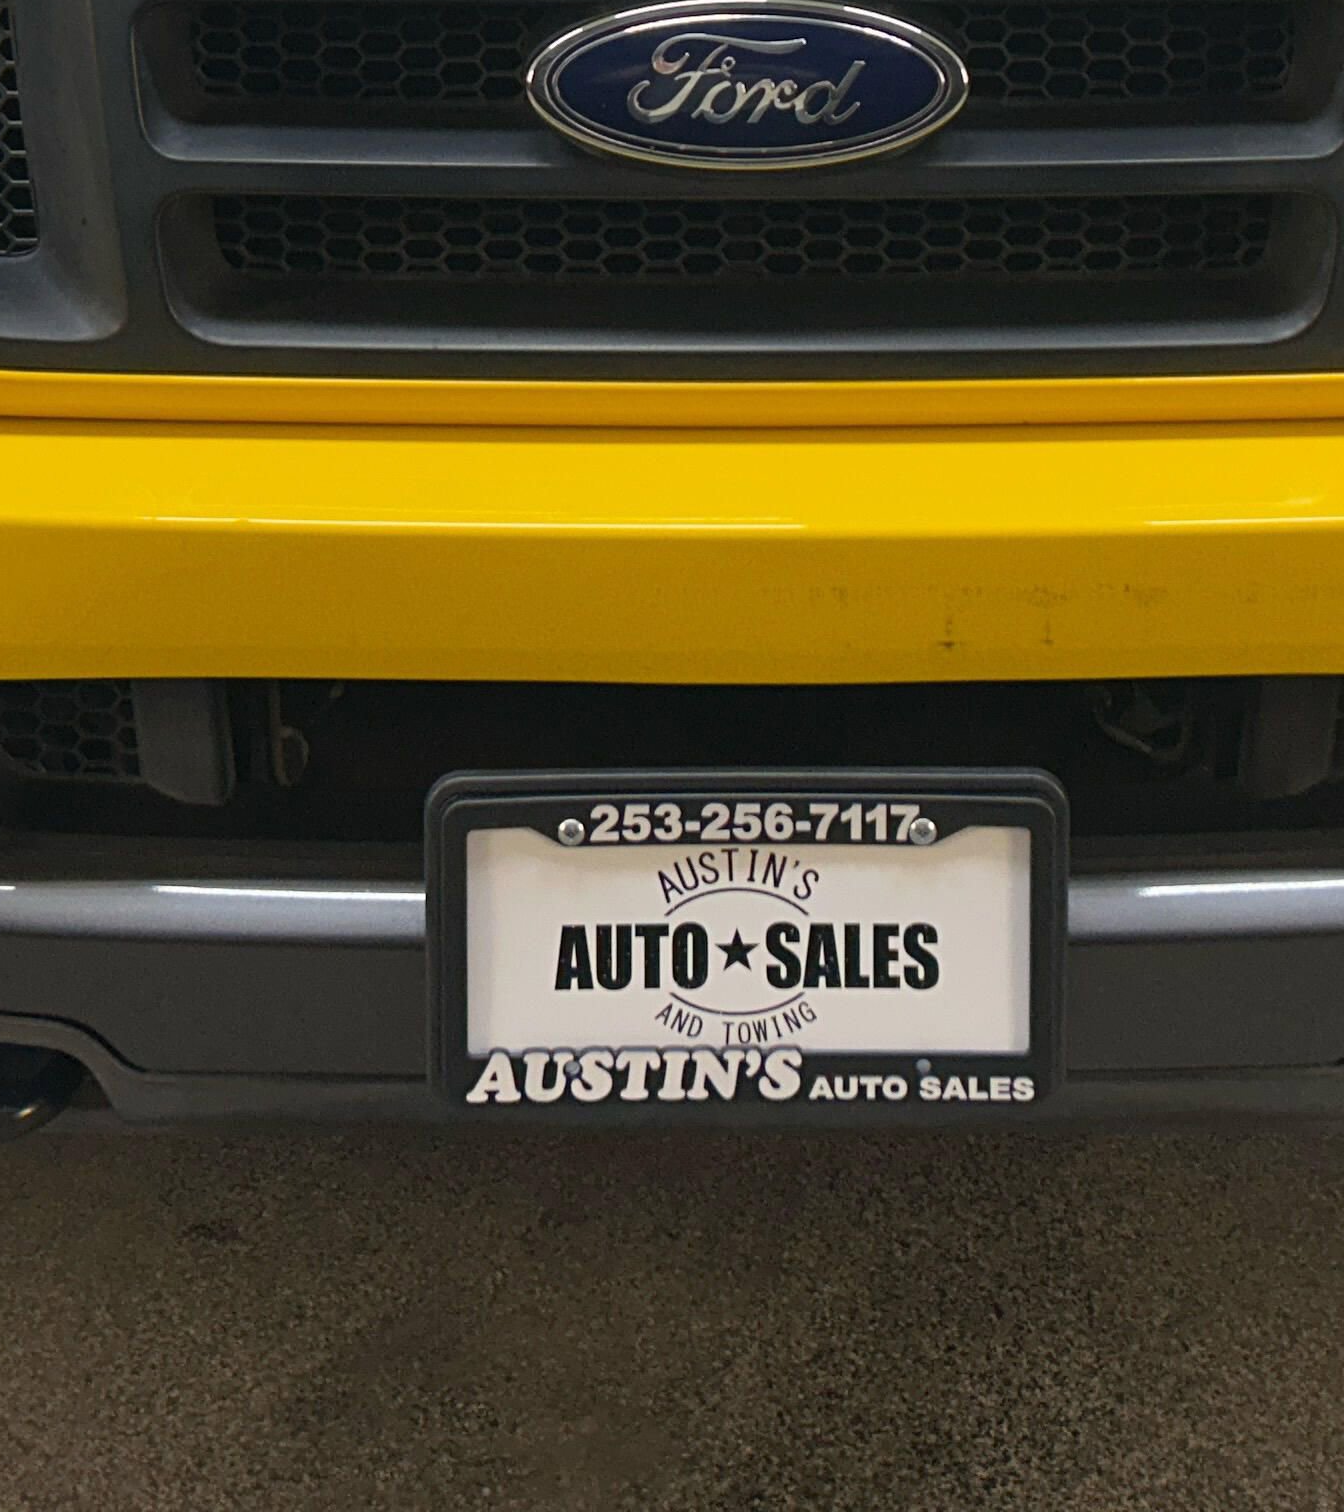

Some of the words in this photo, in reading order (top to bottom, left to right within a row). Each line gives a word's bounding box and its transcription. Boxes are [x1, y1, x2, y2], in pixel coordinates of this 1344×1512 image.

[626, 32, 867, 125] Ford
[588, 802, 921, 843] 253-256-7117
[657, 848, 820, 904] AUSTIN'S
[554, 921, 709, 991] AUTO
[764, 921, 940, 991] SALES
[655, 1002, 705, 1040] AND
[722, 1000, 819, 1048] TOWING
[465, 1047, 804, 1105] AUSTIN'S
[808, 1075, 908, 1101] AUTO
[918, 1075, 1036, 1102] SALES
